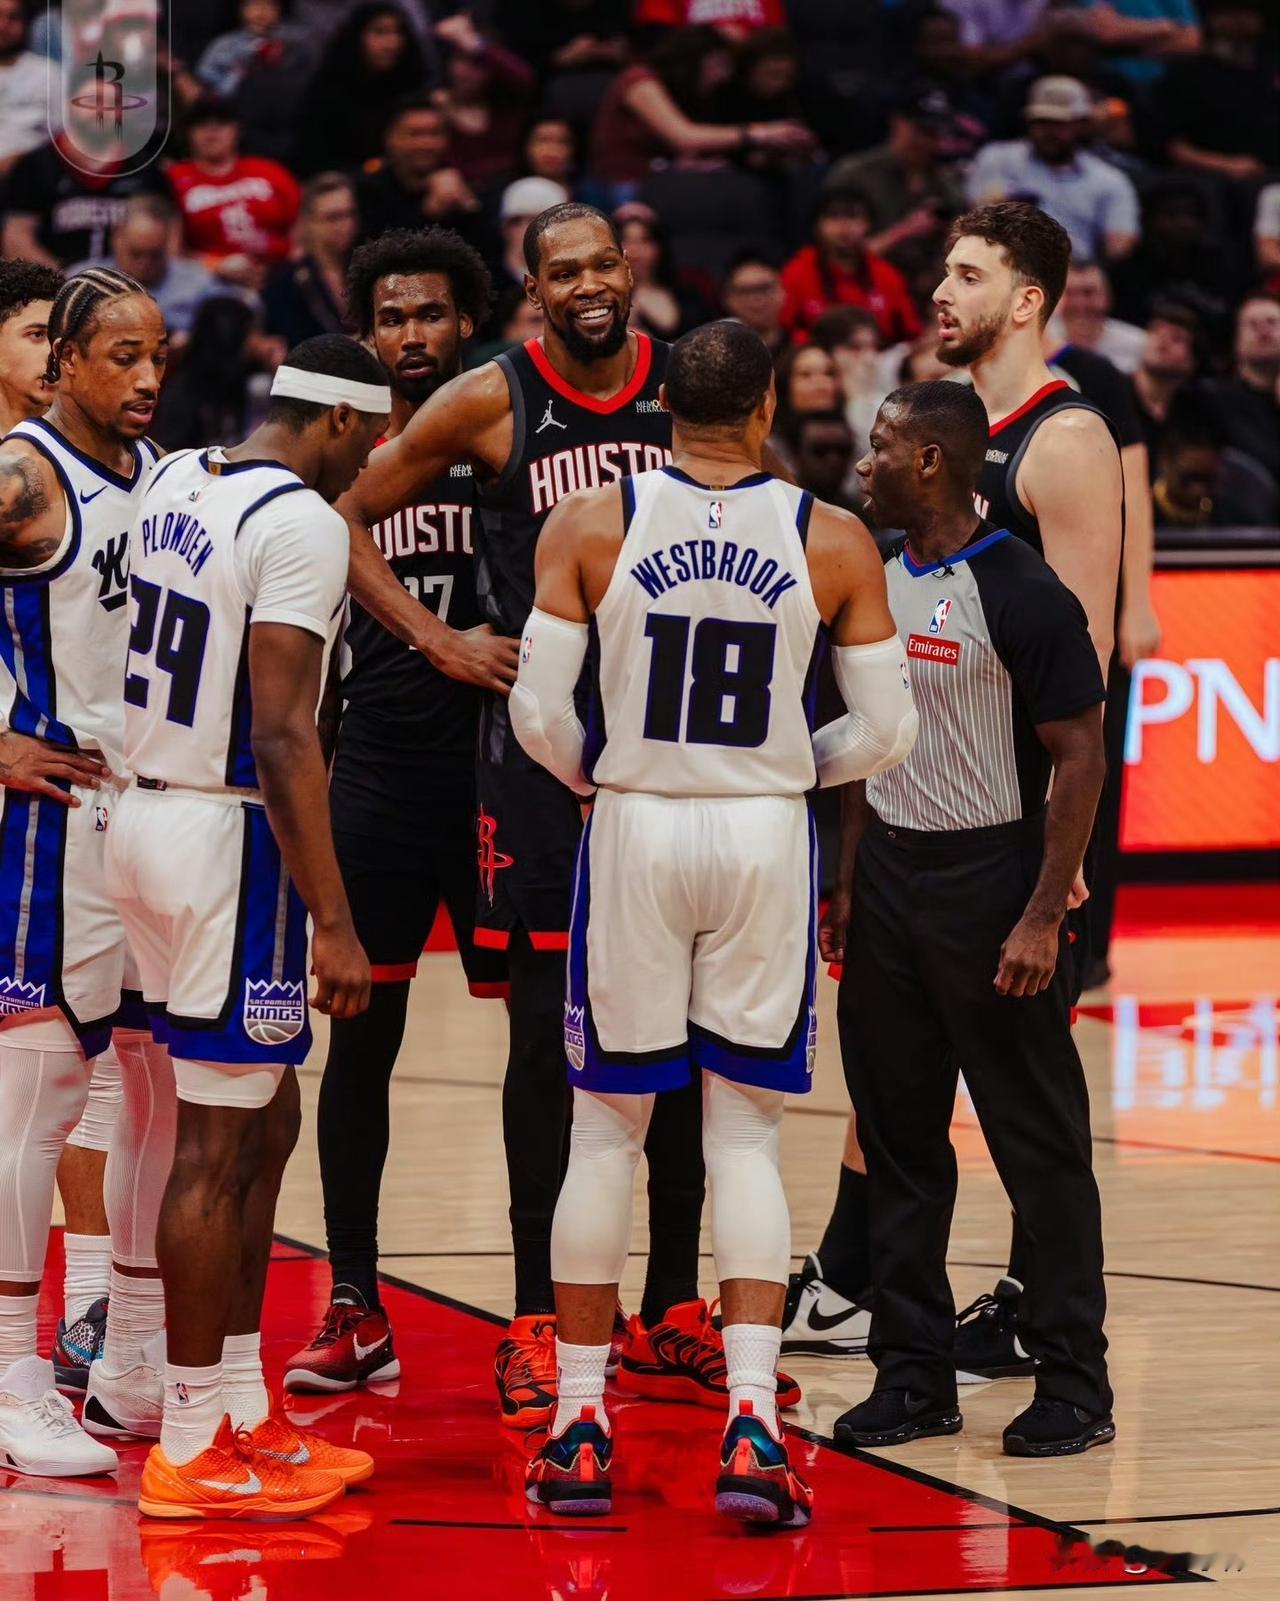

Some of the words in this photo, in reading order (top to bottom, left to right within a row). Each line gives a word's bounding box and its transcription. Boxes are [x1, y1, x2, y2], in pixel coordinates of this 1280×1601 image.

[142, 512, 214, 577] PLOWDEN
[630, 539, 798, 610] WESTBROOK
[123, 573, 211, 728] 29
[642, 612, 778, 748] 18
[908, 638, 958, 660] Emirates
[247, 1007, 303, 1021] KINGS
